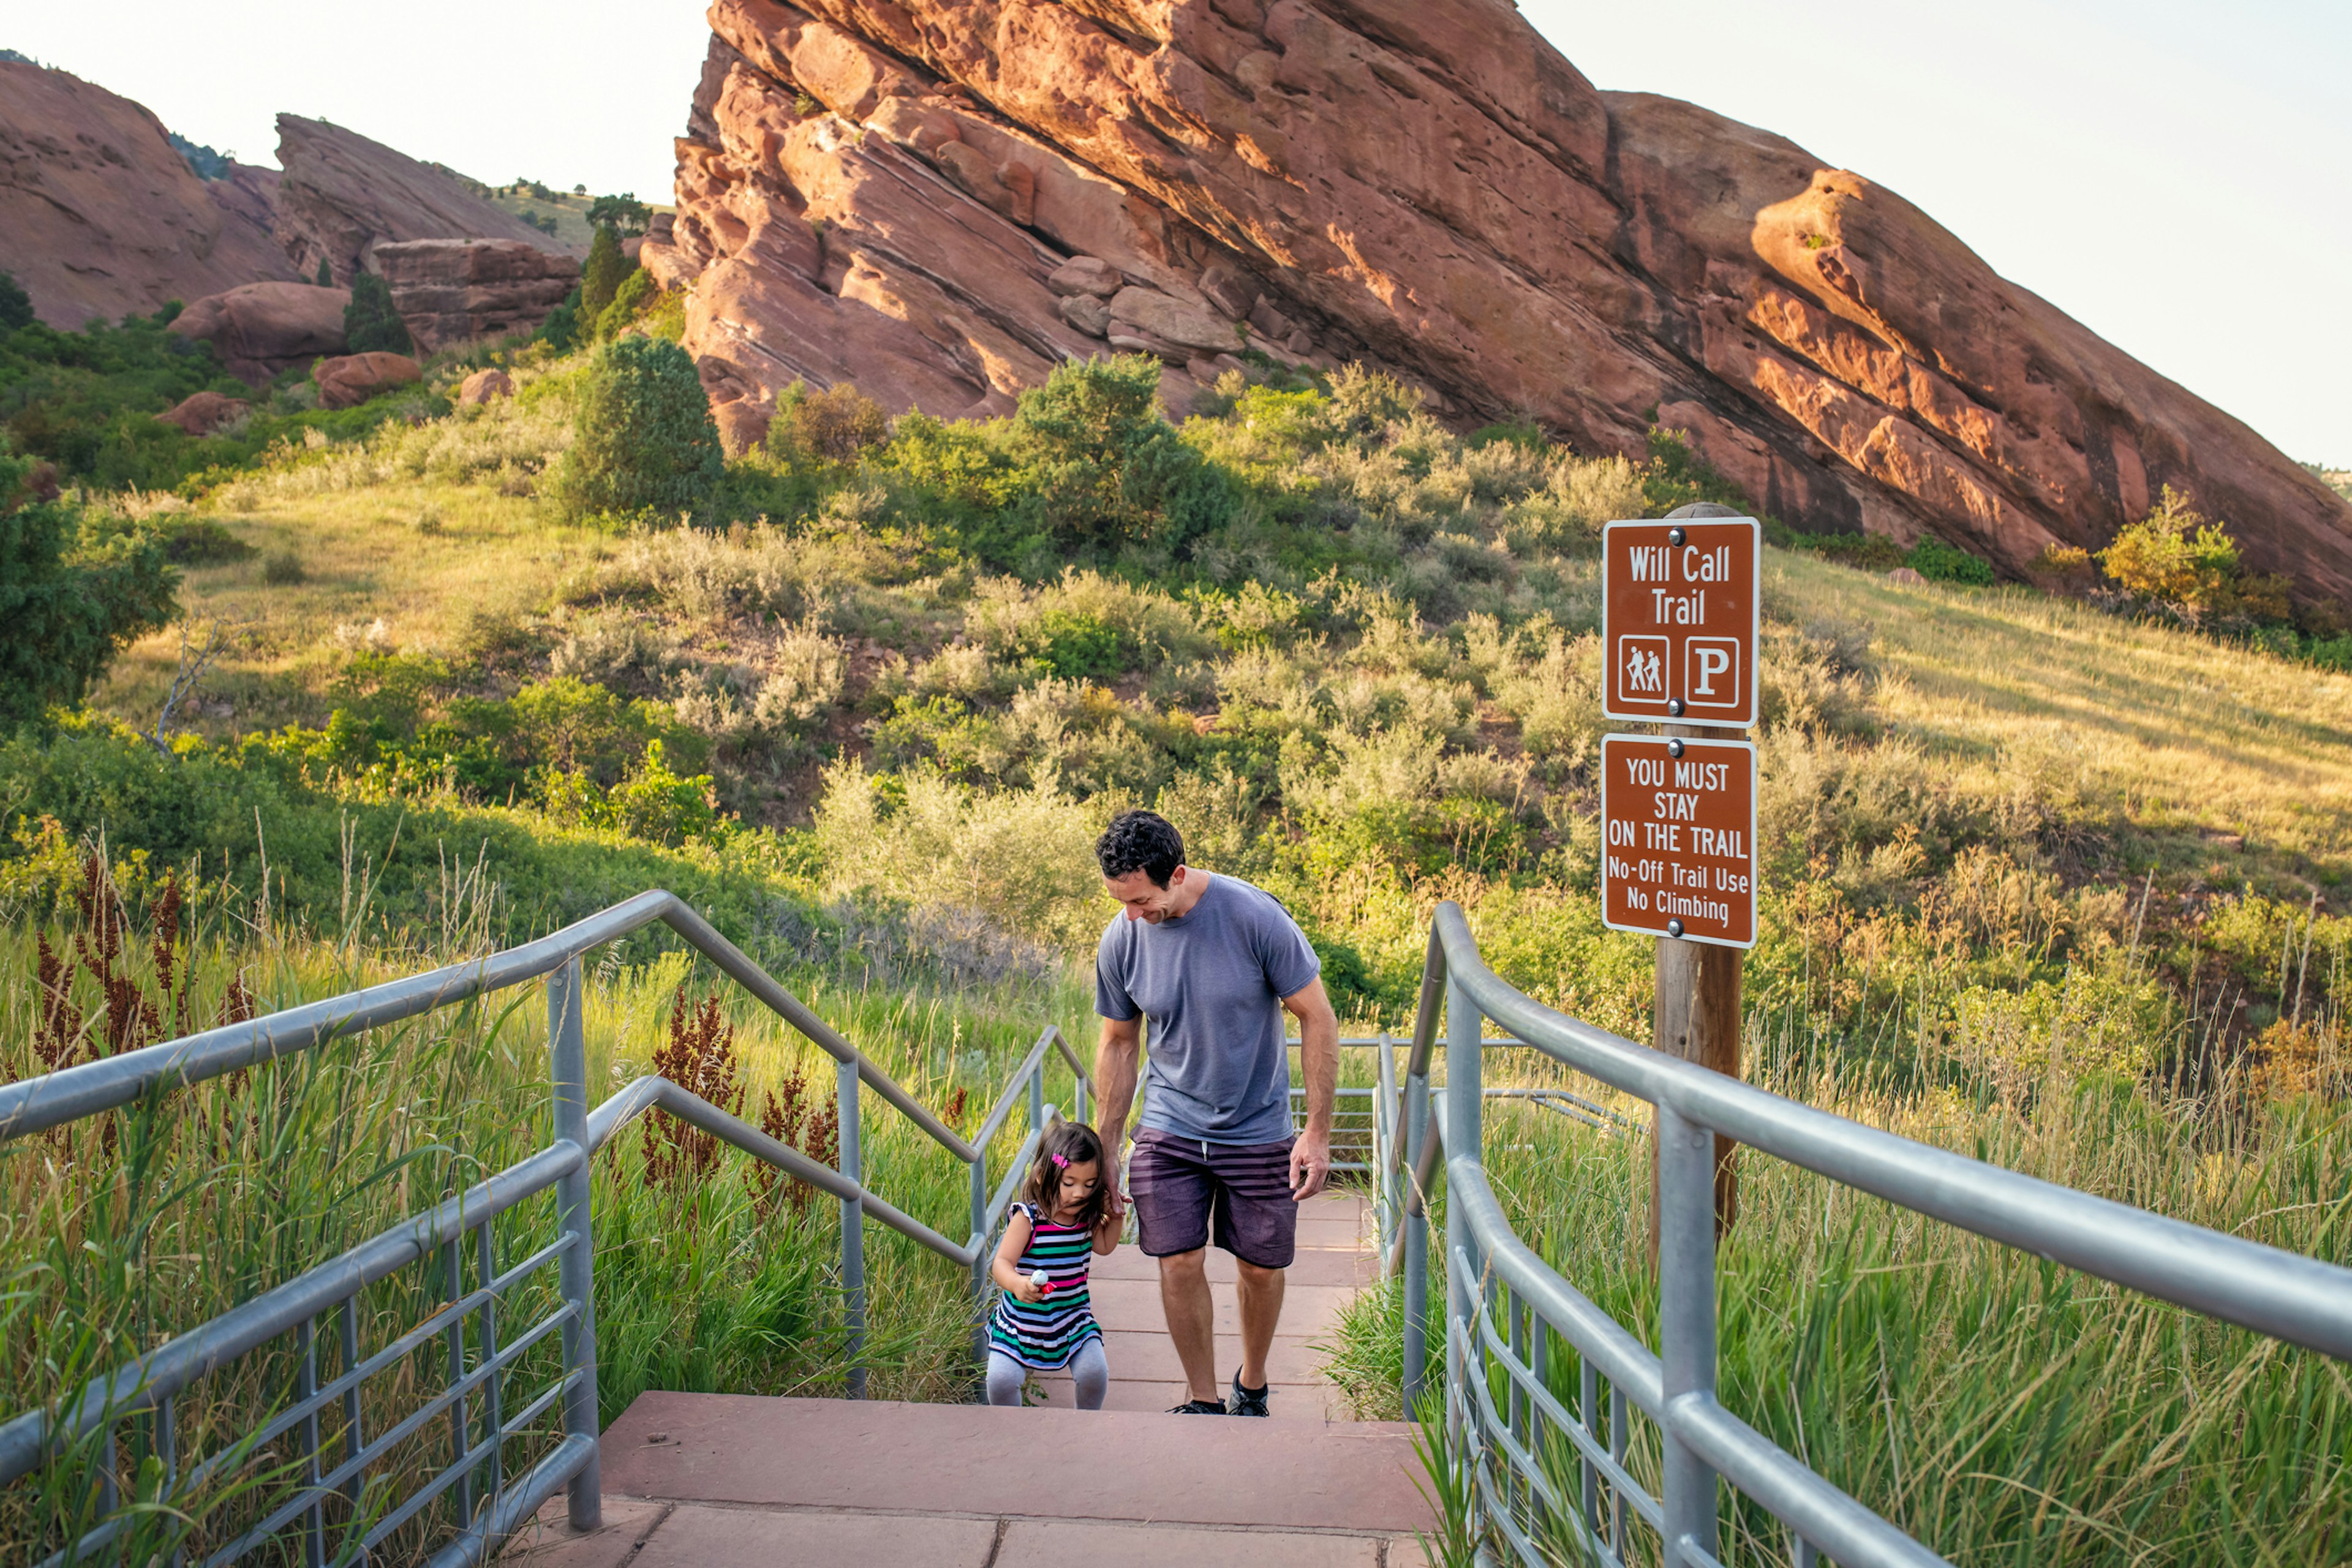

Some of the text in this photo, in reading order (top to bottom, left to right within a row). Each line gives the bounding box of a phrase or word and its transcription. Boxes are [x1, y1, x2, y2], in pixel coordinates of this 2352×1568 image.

[1629, 545, 1730, 582] Will Call
[1651, 588, 1705, 625] Trail
[1694, 647, 1730, 695] P
[1626, 758, 1729, 791] YOU MUST
[1654, 791, 1699, 821] STAY
[1609, 819, 1748, 859] ON THE TRAIL
[1609, 856, 1749, 894] No-Off Trail Use
[1627, 886, 1728, 929] No Climbing
